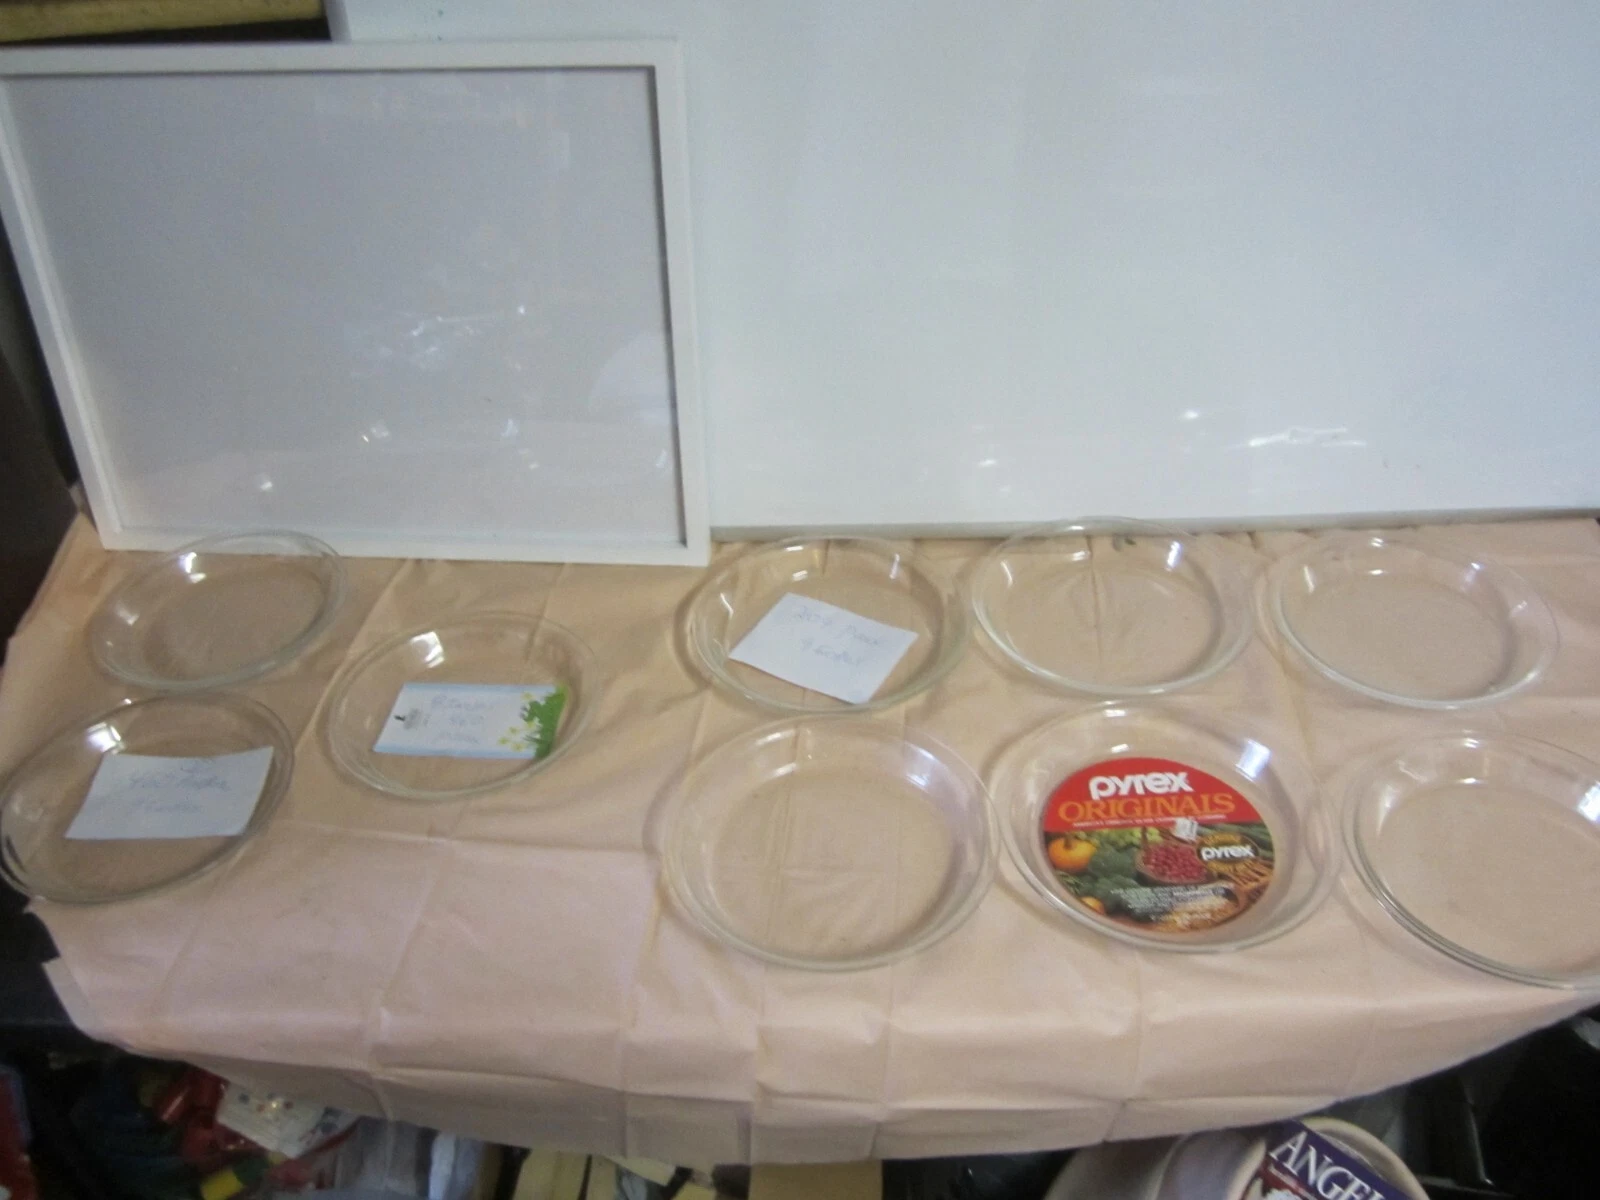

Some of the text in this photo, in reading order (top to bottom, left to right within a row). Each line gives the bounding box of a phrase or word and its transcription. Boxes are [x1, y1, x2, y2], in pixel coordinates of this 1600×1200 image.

[1089, 772, 1194, 799] pyrex
[1058, 793, 1235, 822] ORIGINALS
[1201, 846, 1254, 861] pyrex
